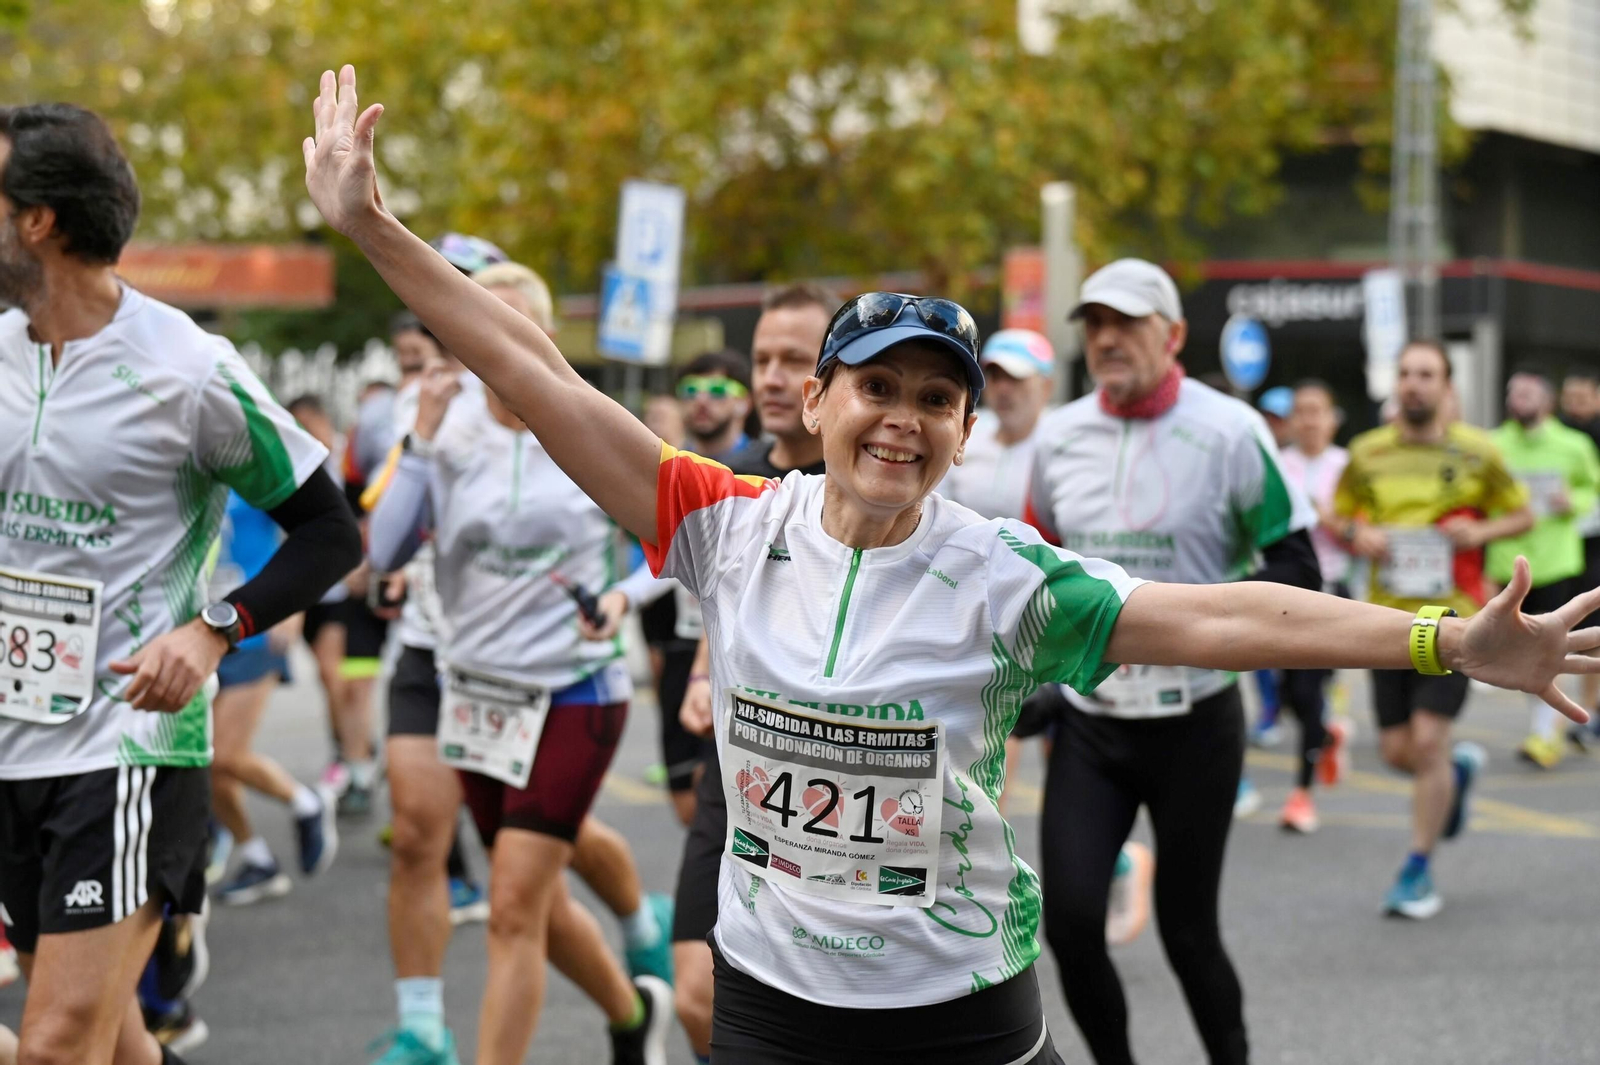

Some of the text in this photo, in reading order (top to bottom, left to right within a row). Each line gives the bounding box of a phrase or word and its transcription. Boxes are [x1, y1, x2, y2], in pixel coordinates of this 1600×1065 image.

[12, 492, 117, 526] SUBIDA
[24, 524, 113, 548] ERMITAS
[926, 567, 959, 590] Laboral
[757, 707, 811, 736] SUBIDA
[813, 723, 825, 739] A
[826, 727, 855, 744] LAS
[857, 730, 927, 748] ERMITAS
[734, 722, 758, 743] POR
[760, 731, 774, 748] LA
[846, 750, 863, 765] DE
[865, 752, 932, 768] ORGANOS
[761, 771, 884, 844] 421
[898, 816, 921, 826] TALLA
[905, 828, 915, 836] XS
[774, 835, 876, 861] ESPERANZA MIRANDA GÓMEZ
